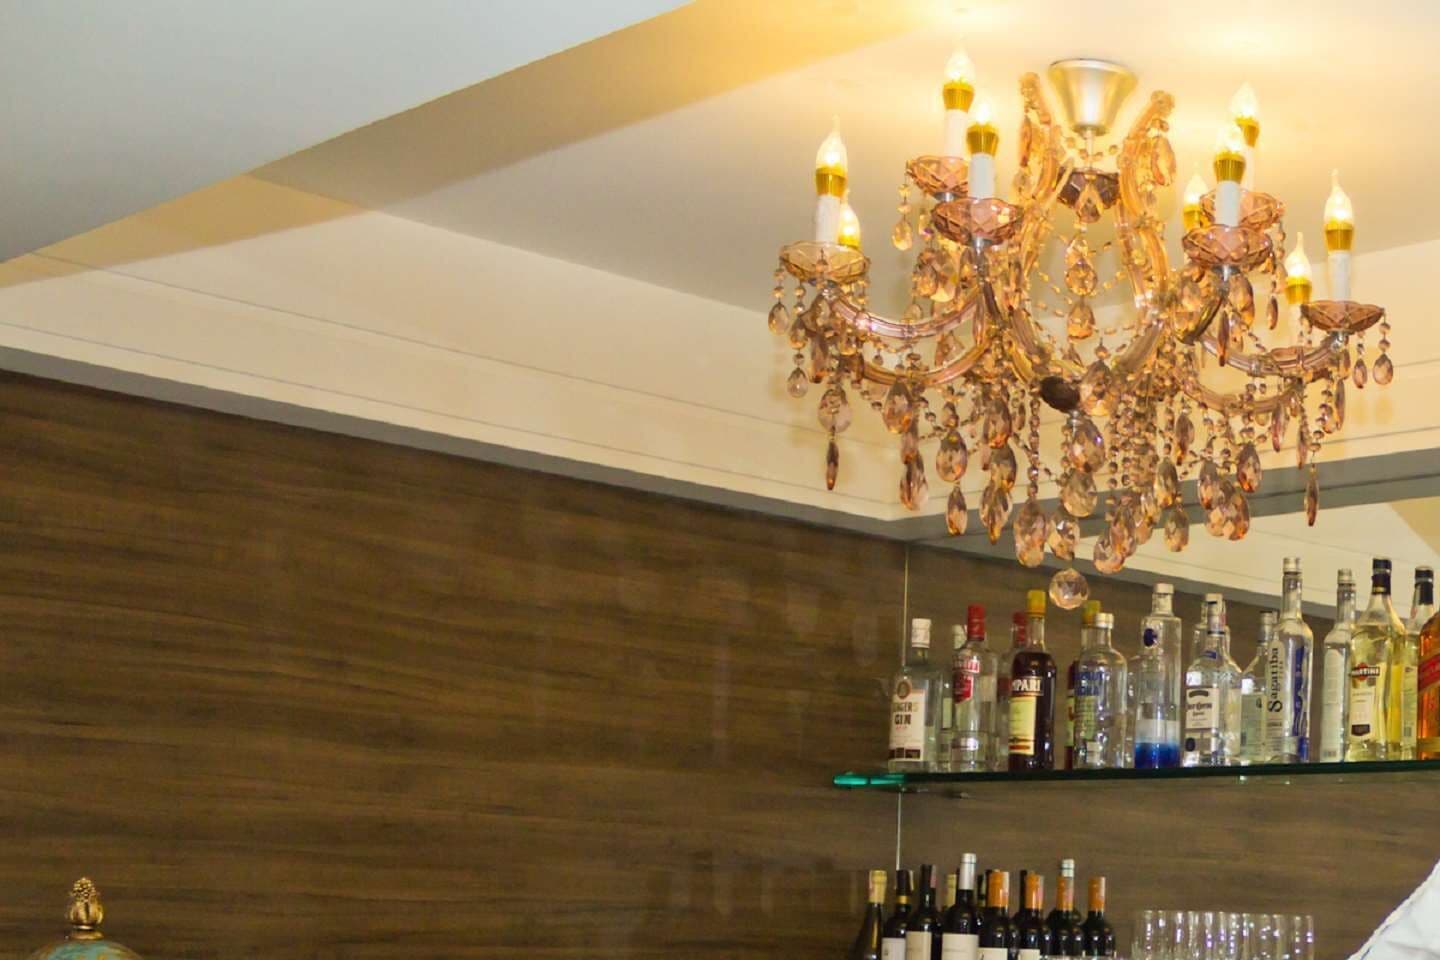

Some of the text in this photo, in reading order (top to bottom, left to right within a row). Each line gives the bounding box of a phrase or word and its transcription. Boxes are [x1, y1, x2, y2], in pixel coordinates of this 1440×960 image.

[1350, 667, 1380, 676] MARTINI
[1267, 648, 1283, 713] Sagatiba
[894, 714, 912, 725] GIN
